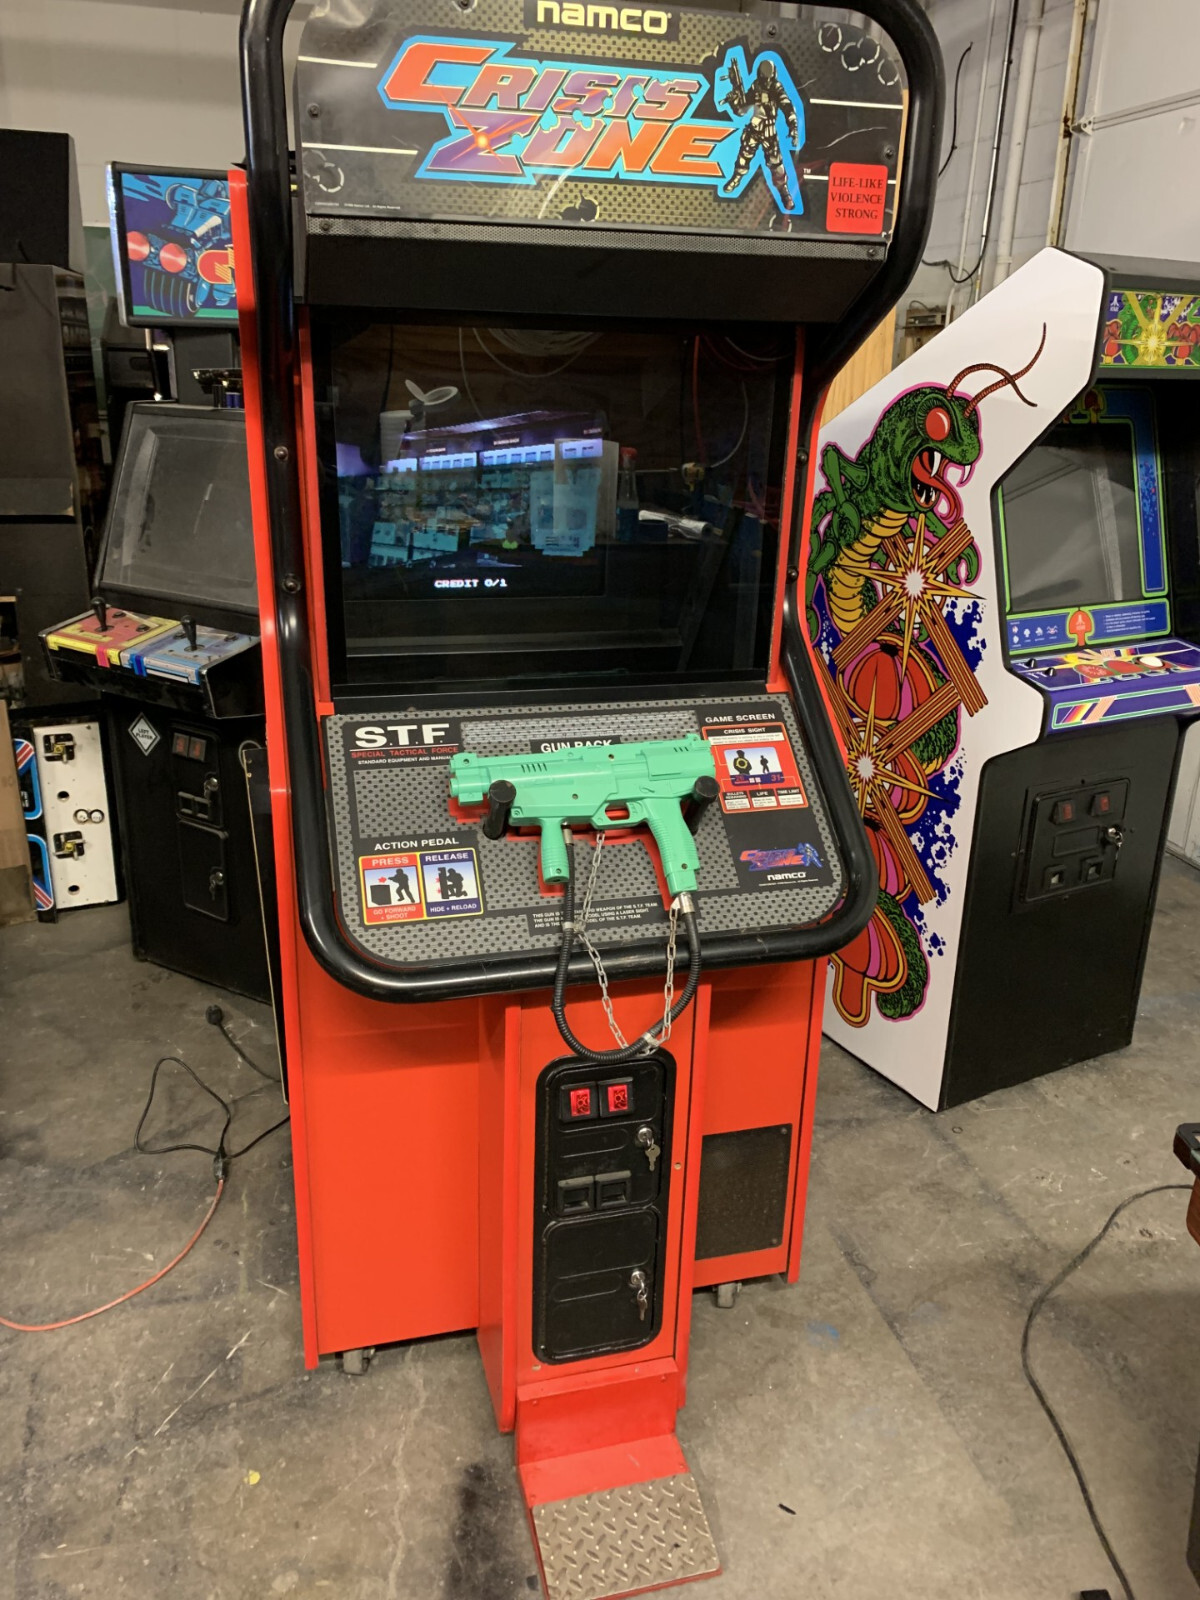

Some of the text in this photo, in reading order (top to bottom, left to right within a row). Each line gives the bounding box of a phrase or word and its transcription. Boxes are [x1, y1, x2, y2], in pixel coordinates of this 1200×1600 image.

[537, 0, 668, 35] namco
[384, 42, 701, 121] CRISIS
[426, 106, 738, 176] ZONE
[832, 177, 884, 189] LIFE-LIKE
[830, 192, 882, 204] VIOLENCE
[835, 209, 878, 219] STRONG
[434, 578, 507, 588] CREDIT 0/1
[736, 713, 775, 721] SCREEN
[355, 723, 450, 748] S.T.F.
[541, 742, 571, 753] GUN
[390, 749, 428, 757] TACTICAL
[374, 837, 460, 851] ACTION PEDAL
[372, 857, 409, 866] PRESS
[425, 852, 469, 862] RELEASE
[767, 872, 806, 881] namco
[384, 906, 416, 914] FORWARD
